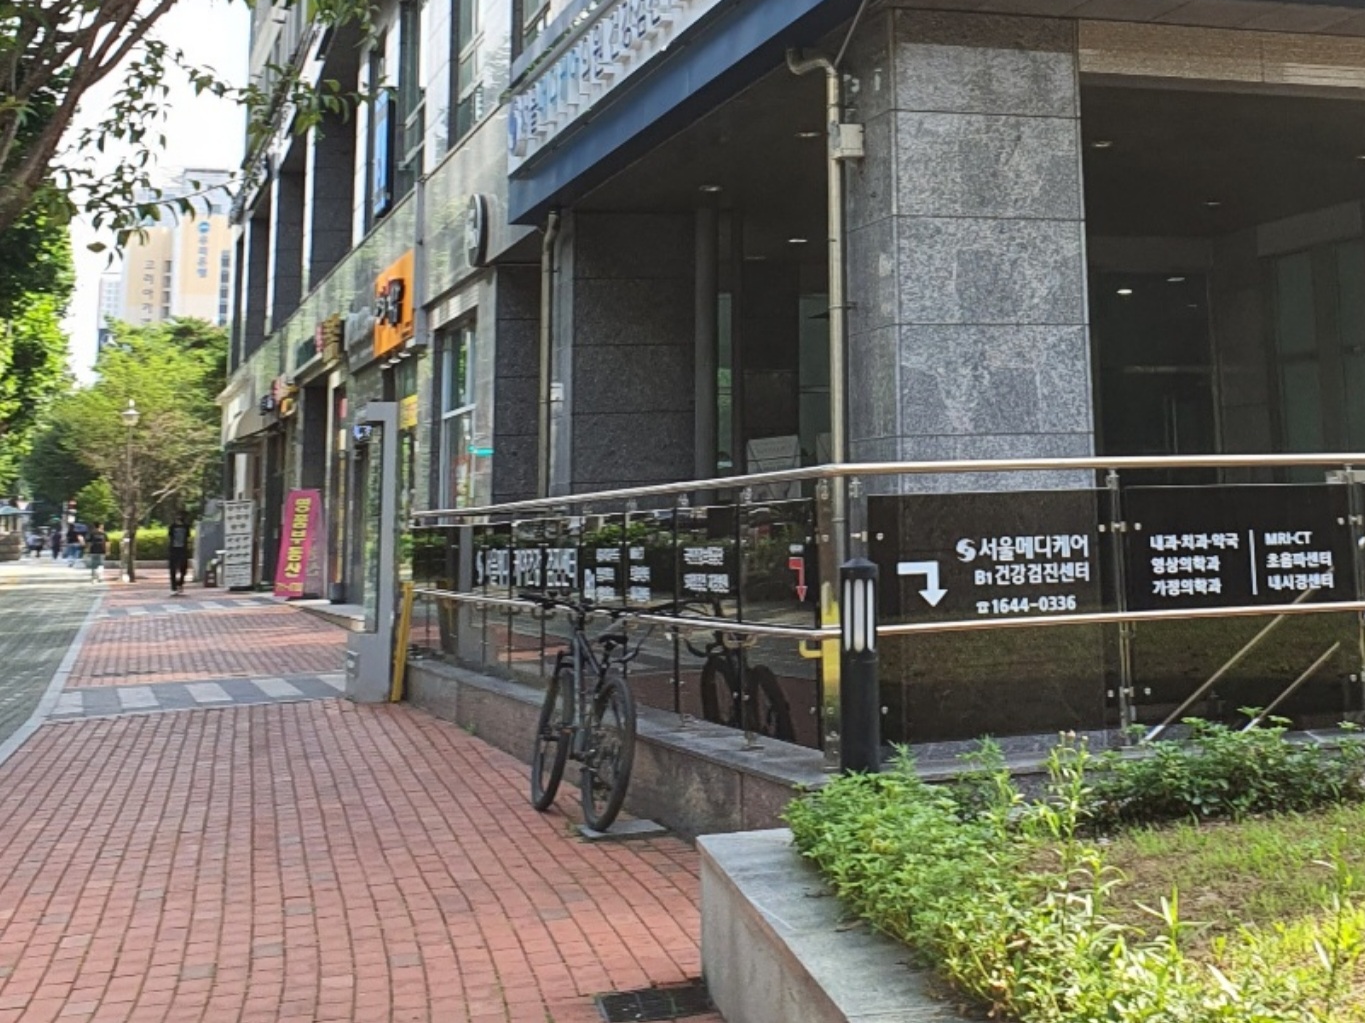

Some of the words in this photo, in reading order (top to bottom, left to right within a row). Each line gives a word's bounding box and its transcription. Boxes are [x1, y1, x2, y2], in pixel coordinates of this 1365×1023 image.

[979, 534, 1090, 562] 서울메디케어
[994, 561, 1091, 586] 건강검진센터
[1150, 555, 1222, 575] 영상의학과
[1151, 577, 1223, 597] 가정의학과
[1267, 572, 1335, 591] 내시경센터
[991, 595, 1077, 615] 1644-0336
